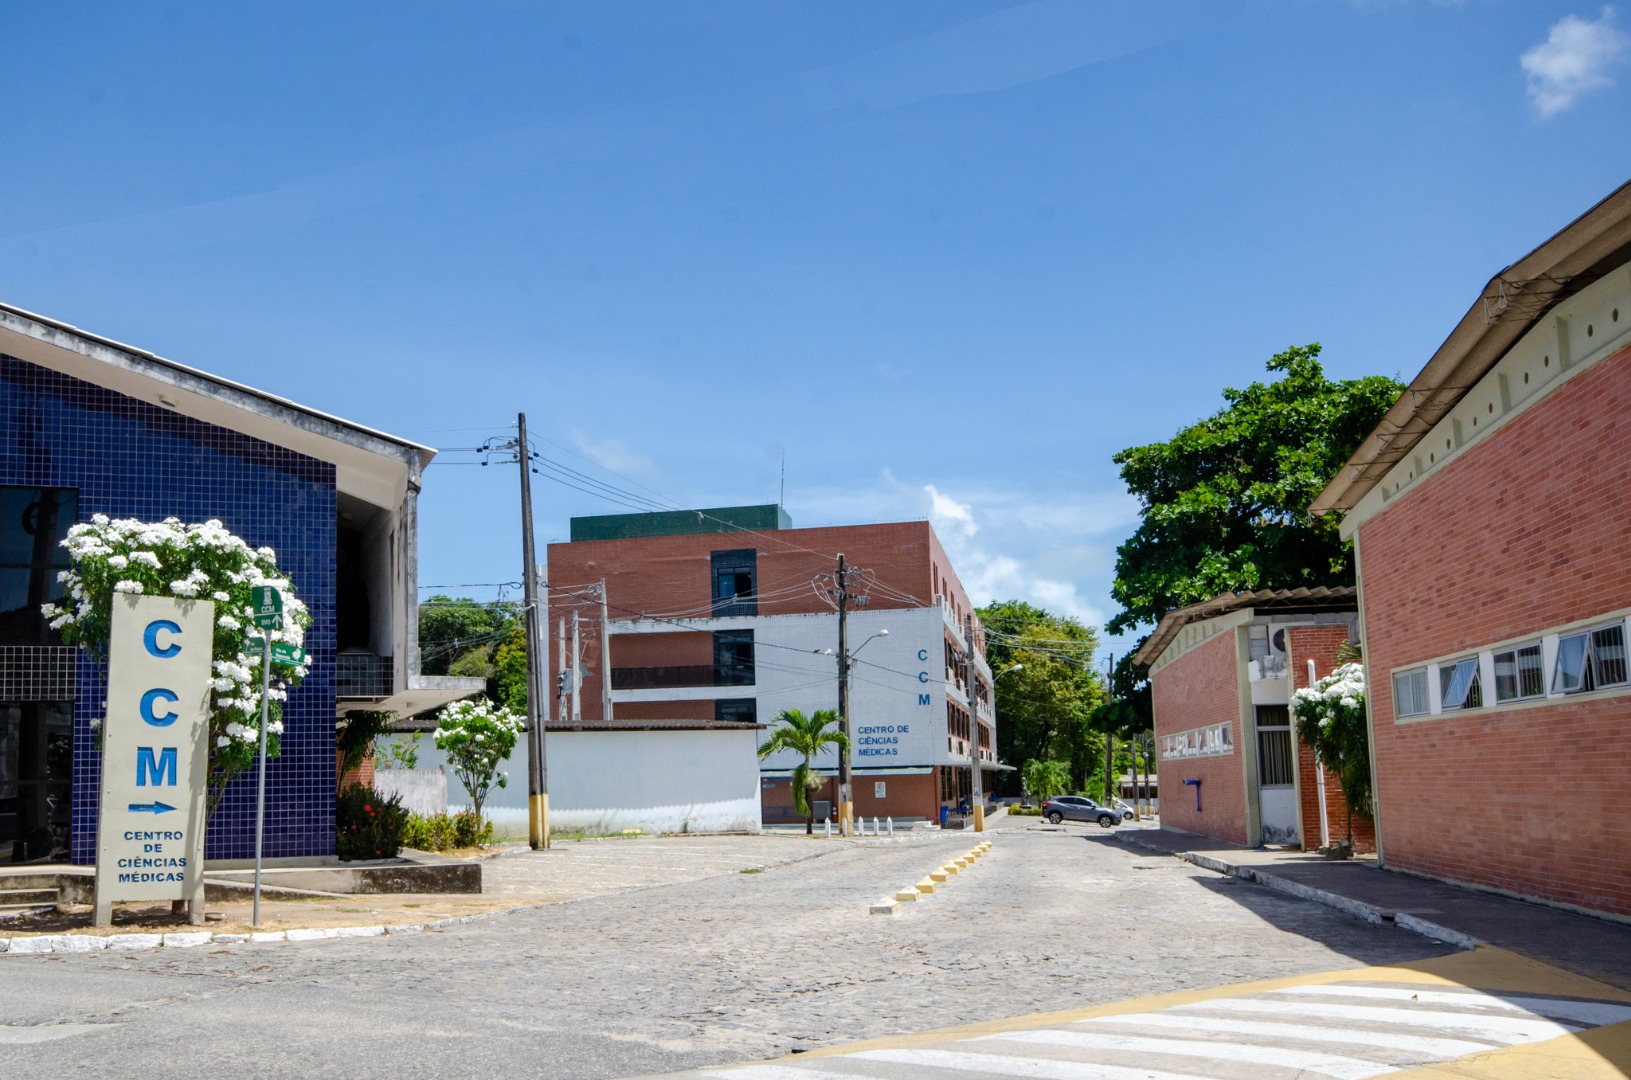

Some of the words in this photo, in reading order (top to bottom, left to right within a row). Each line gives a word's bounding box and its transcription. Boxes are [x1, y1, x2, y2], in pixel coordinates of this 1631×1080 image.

[261, 605, 275, 613] CCM
[858, 725, 895, 734] CENTRO
[897, 725, 909, 733] DE
[858, 736, 899, 745] CIÊNCIAS
[858, 746, 898, 756] MÉDICAS
[123, 831, 184, 841] CENTRO
[143, 844, 163, 853] DE
[117, 856, 187, 868] CIÊNCIAS
[118, 871, 185, 883] MÉDICAS
